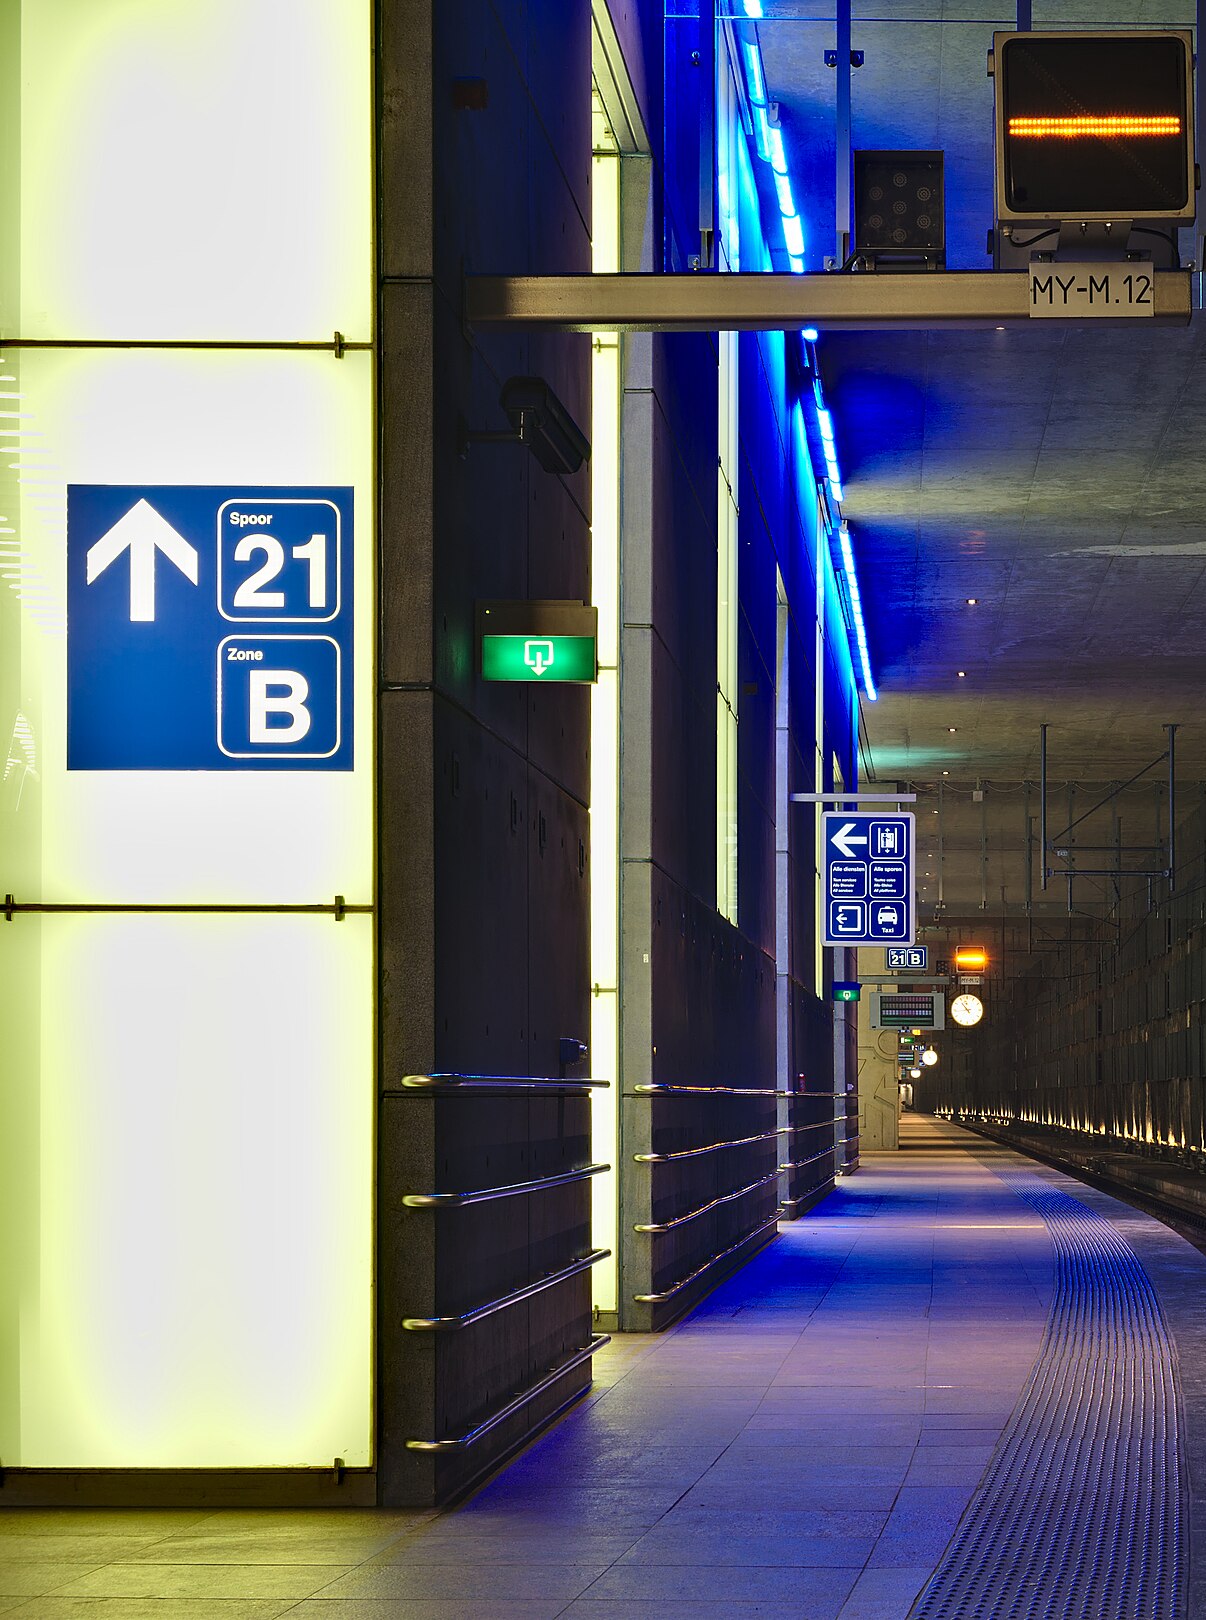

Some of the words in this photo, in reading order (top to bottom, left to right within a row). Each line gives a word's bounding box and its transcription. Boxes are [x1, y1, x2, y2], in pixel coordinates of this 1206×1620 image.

[1033, 275, 1151, 304] MY-M.12
[230, 512, 272, 526] Spoor
[234, 534, 325, 607] 21
[227, 648, 263, 661] Zone
[249, 669, 311, 743] B
[892, 954, 904, 965] 21
[911, 954, 921, 965] B
